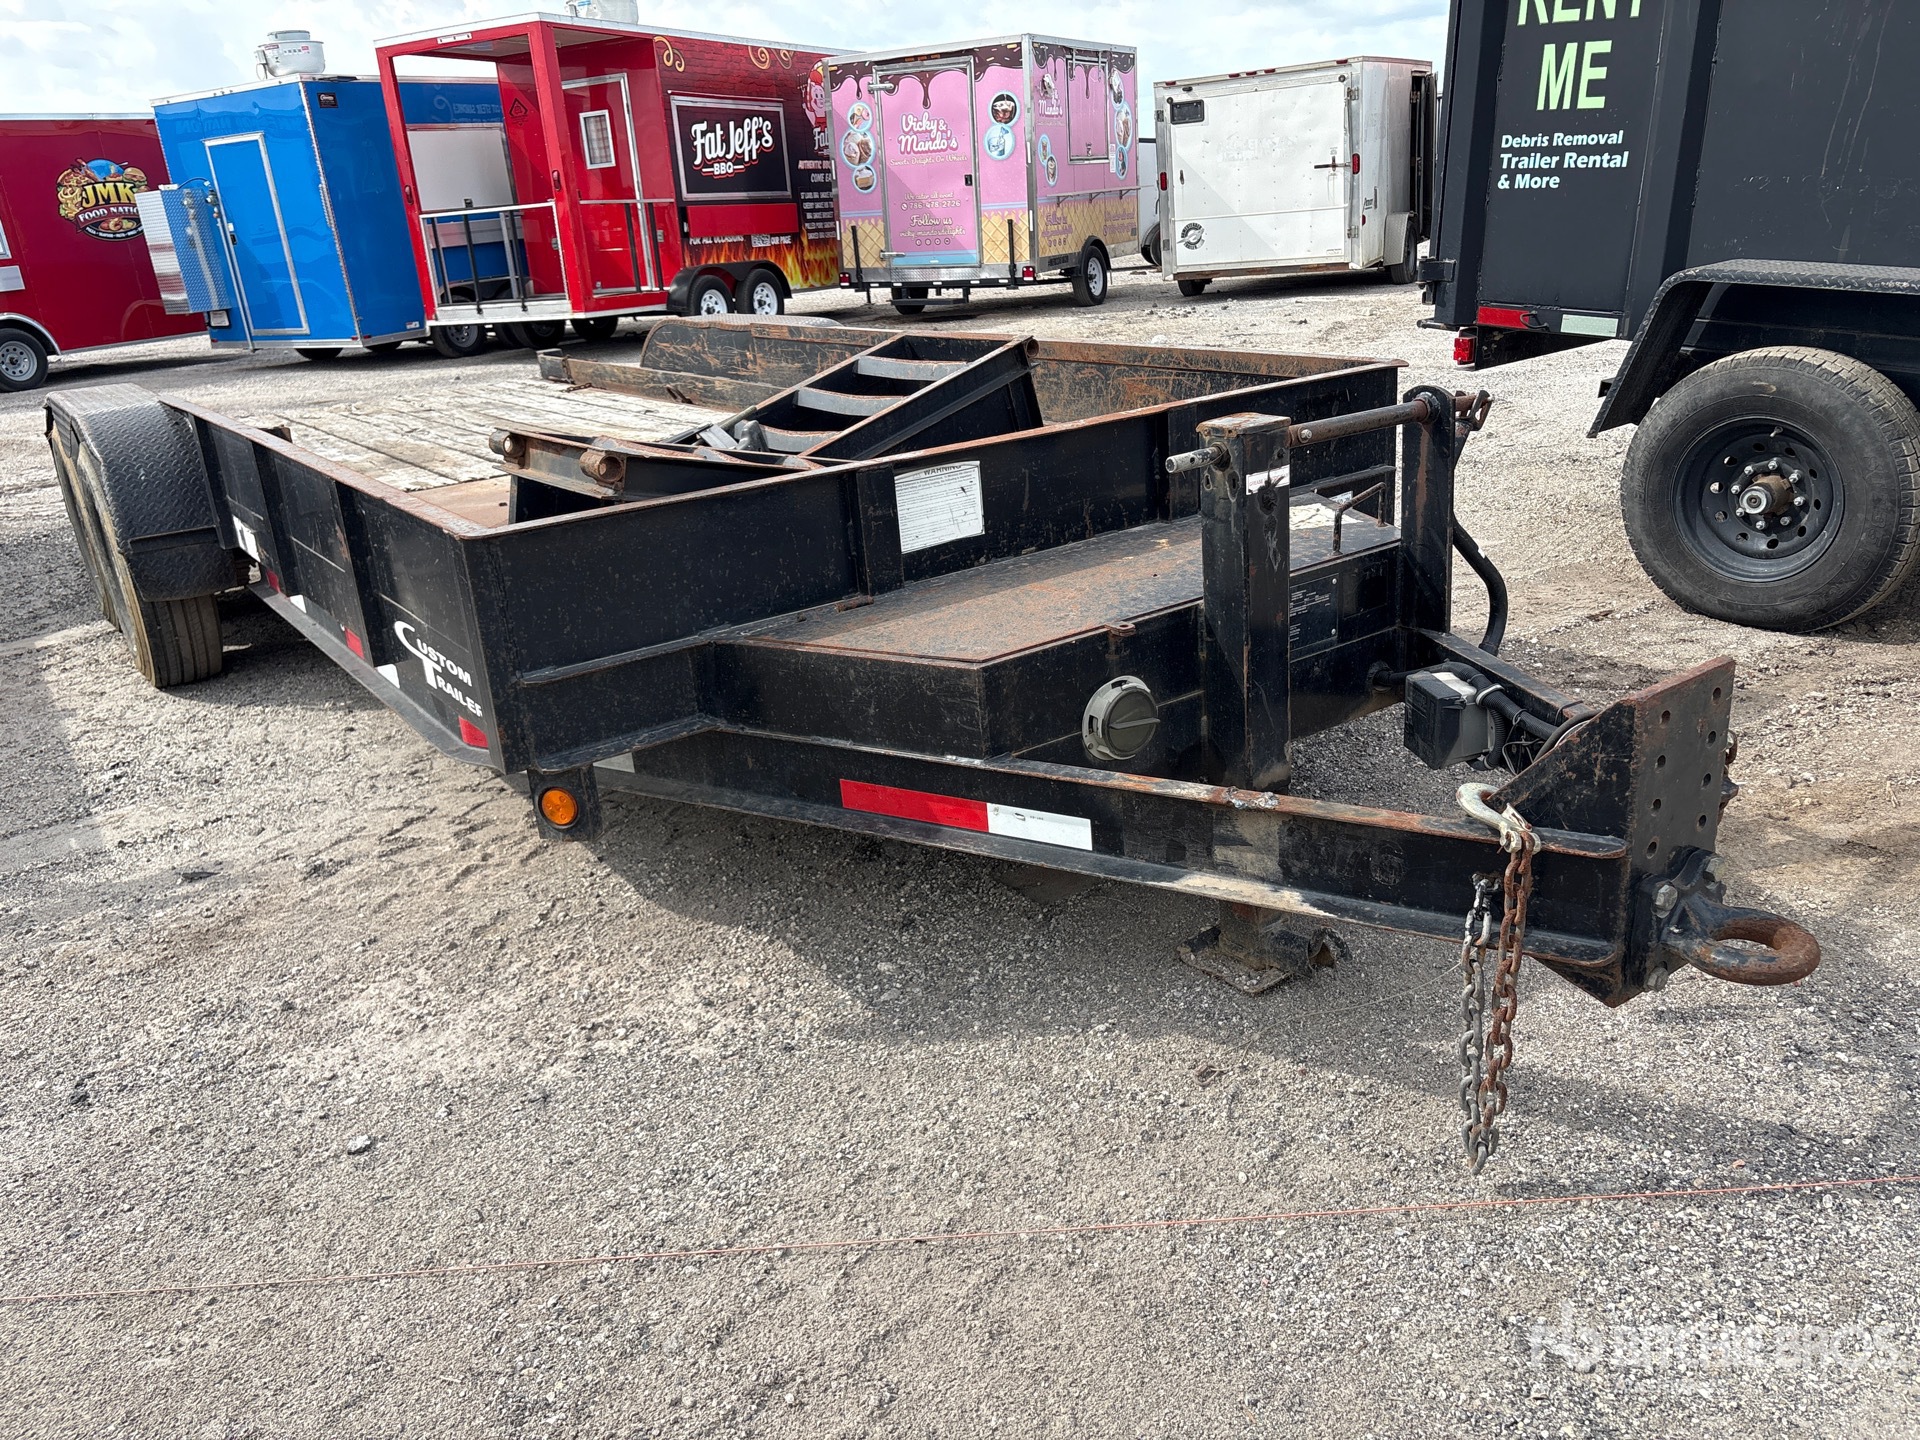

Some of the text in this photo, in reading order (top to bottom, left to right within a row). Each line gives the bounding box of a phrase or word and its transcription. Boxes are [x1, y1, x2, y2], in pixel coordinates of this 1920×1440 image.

[1536, 40, 1613, 111] ME
[901, 111, 938, 138] Vicky
[690, 116, 774, 166] Fat Jeff's
[898, 129, 958, 152] Mando's
[1501, 130, 1624, 148] Debris Removal
[713, 162, 735, 175] BBQ
[1500, 151, 1629, 169] Trailer Rental
[811, 173, 825, 182] COME
[1497, 174, 1560, 189] & More
[82, 182, 137, 208] JMK
[78, 206, 139, 223] FOOD NATIO
[910, 213, 953, 227] Follow us
[394, 620, 473, 687] CUSTOM
